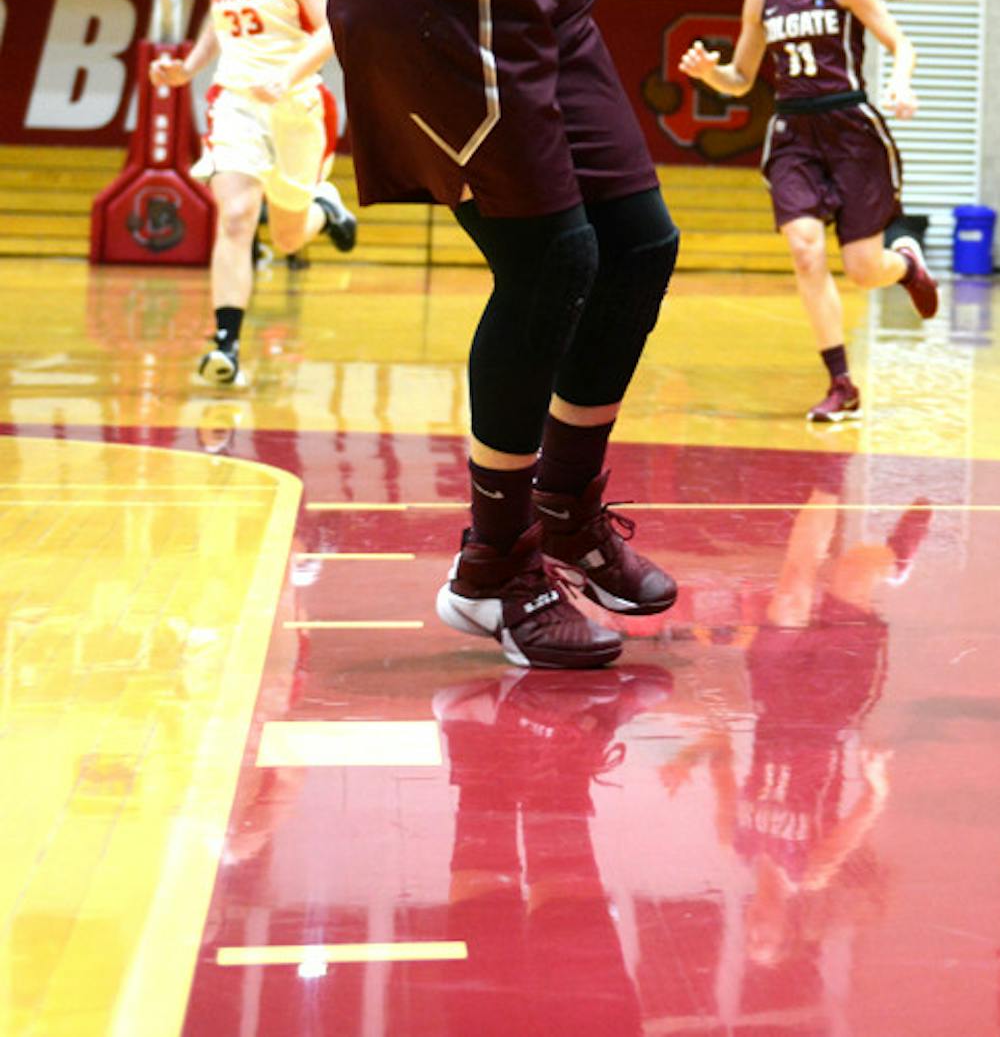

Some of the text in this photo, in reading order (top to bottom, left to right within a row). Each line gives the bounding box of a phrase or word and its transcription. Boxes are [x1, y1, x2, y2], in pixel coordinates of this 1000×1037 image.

[222, 7, 265, 38] 33
[763, 8, 840, 44] OLGATE
[783, 41, 817, 78] 11
